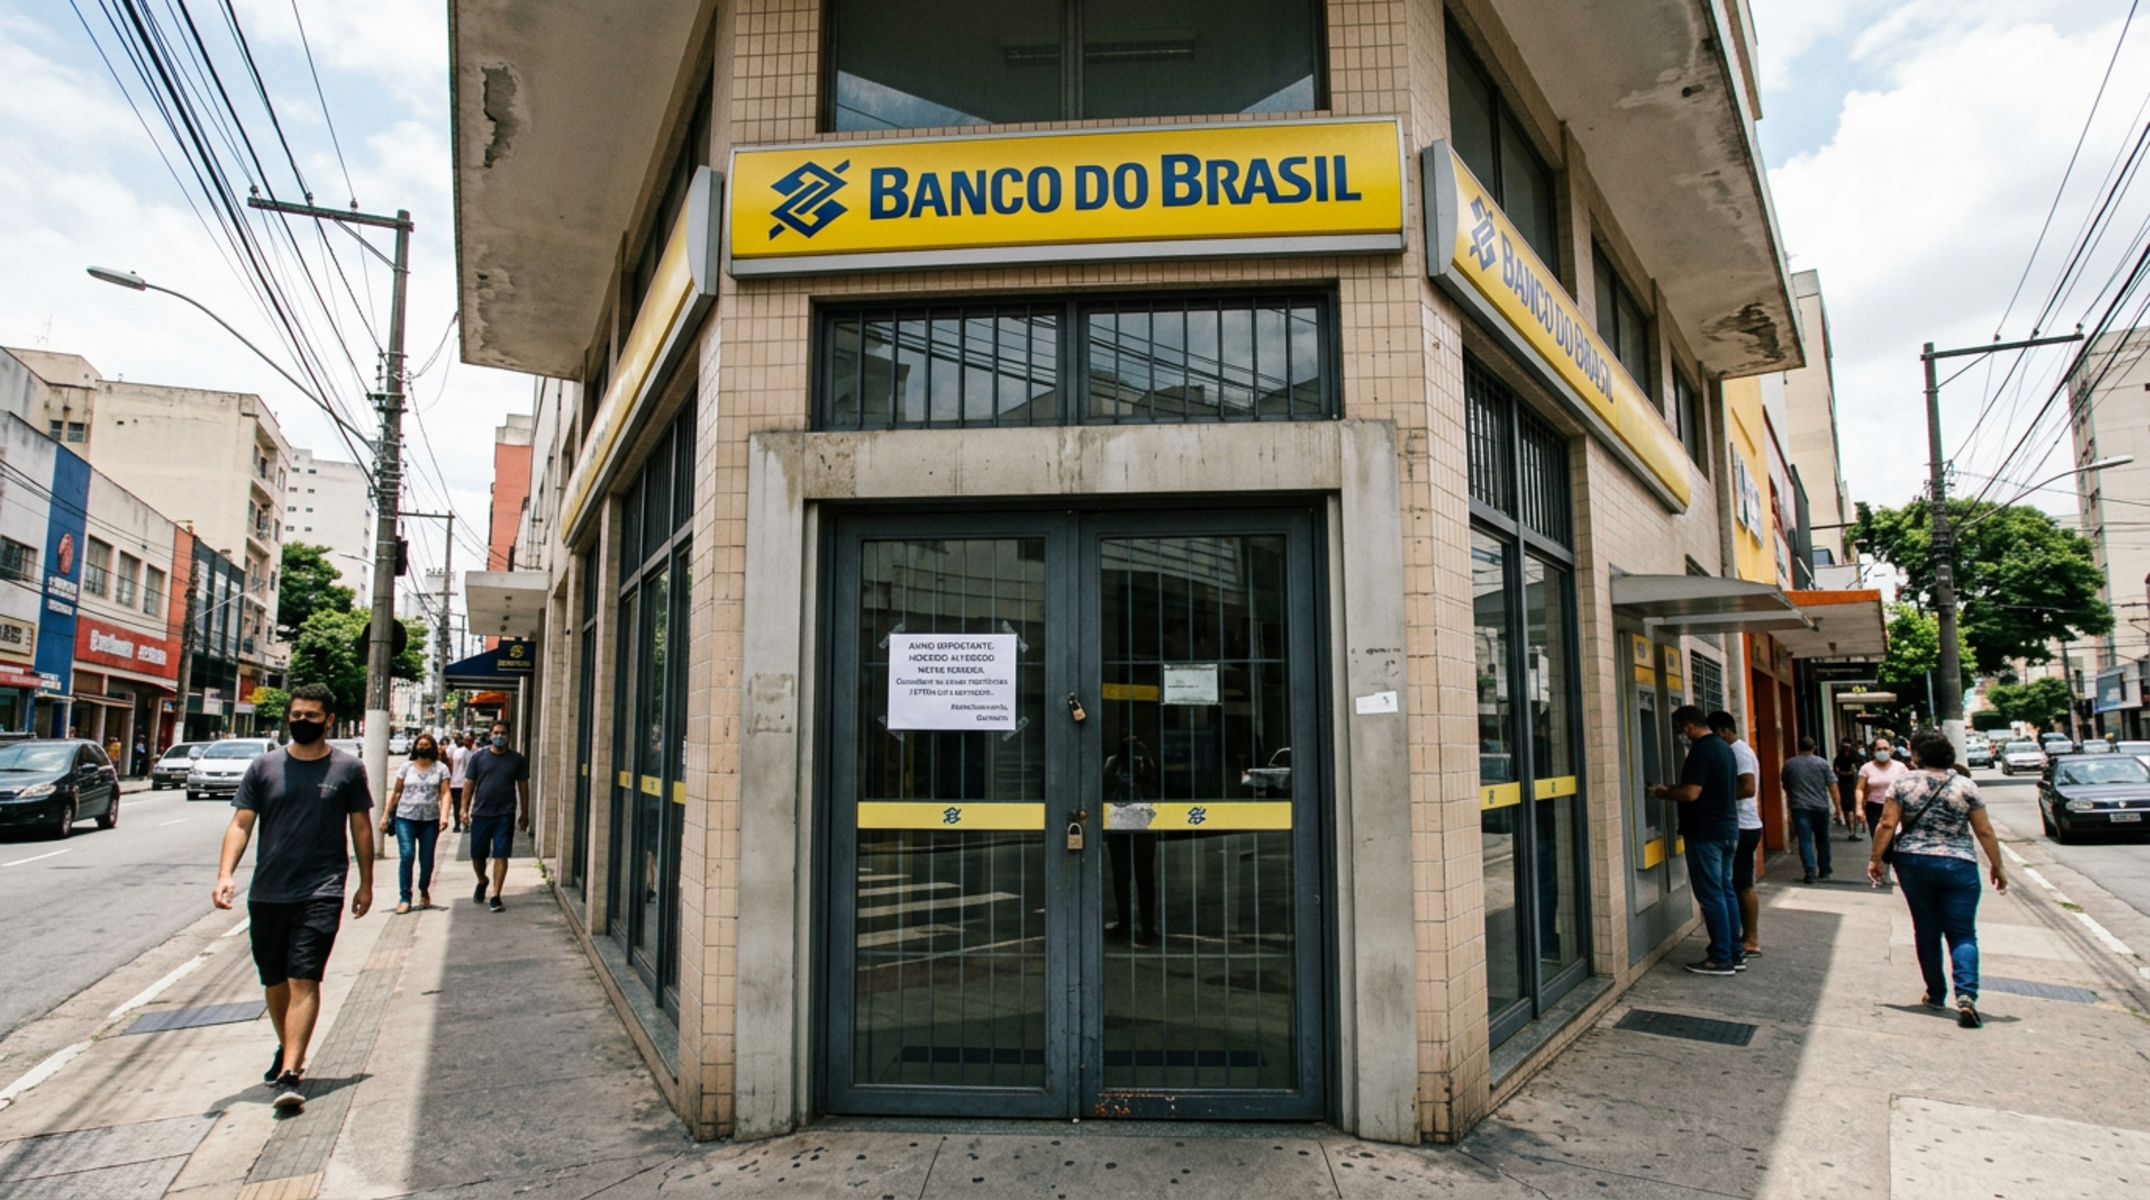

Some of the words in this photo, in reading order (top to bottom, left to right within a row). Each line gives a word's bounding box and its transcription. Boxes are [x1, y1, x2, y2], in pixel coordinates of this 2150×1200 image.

[870, 166, 1061, 220] BANCO
[1074, 161, 1149, 210] DO
[1160, 153, 1362, 207] BRASIL
[1500, 230, 1554, 335] BANCO
[1555, 303, 1573, 357] DO
